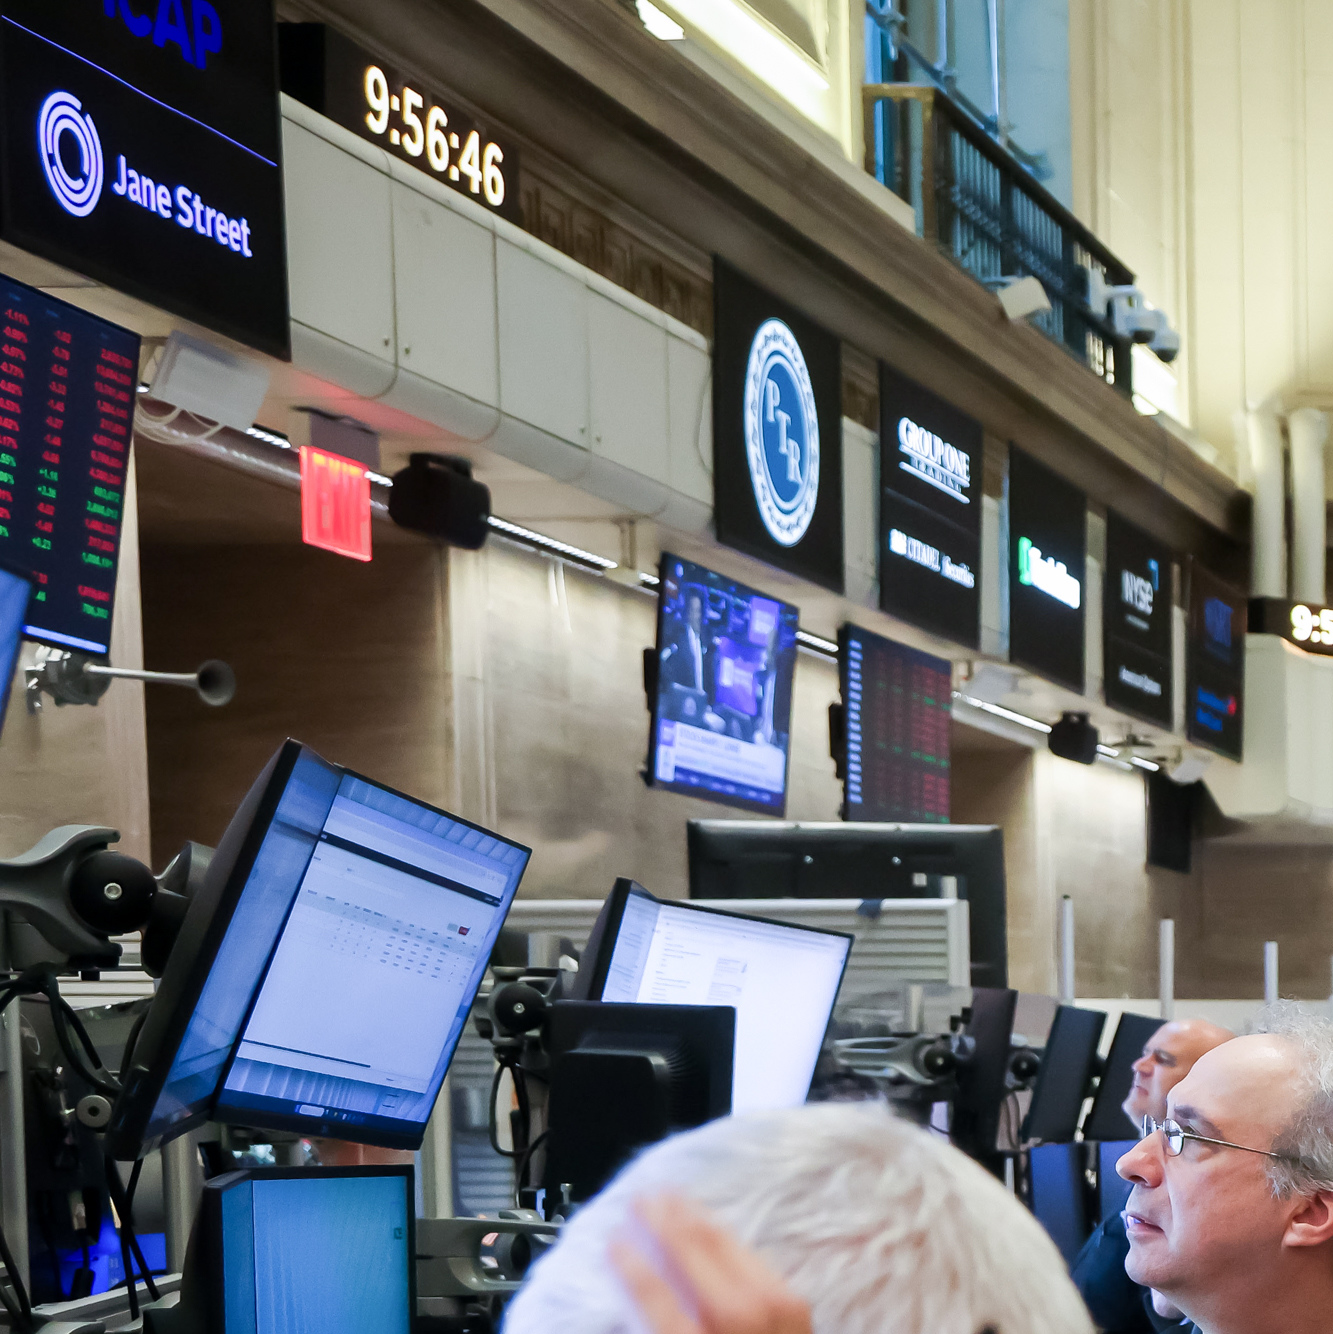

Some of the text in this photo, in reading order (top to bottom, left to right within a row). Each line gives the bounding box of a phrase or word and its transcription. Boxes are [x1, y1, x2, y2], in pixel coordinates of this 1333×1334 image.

[102, 0, 223, 70] CAP
[363, 64, 506, 207] 9:56:46
[111, 154, 253, 258] Jane Street
[898, 416, 971, 482] GROUP ONE
[905, 536, 941, 573] CITADEL
